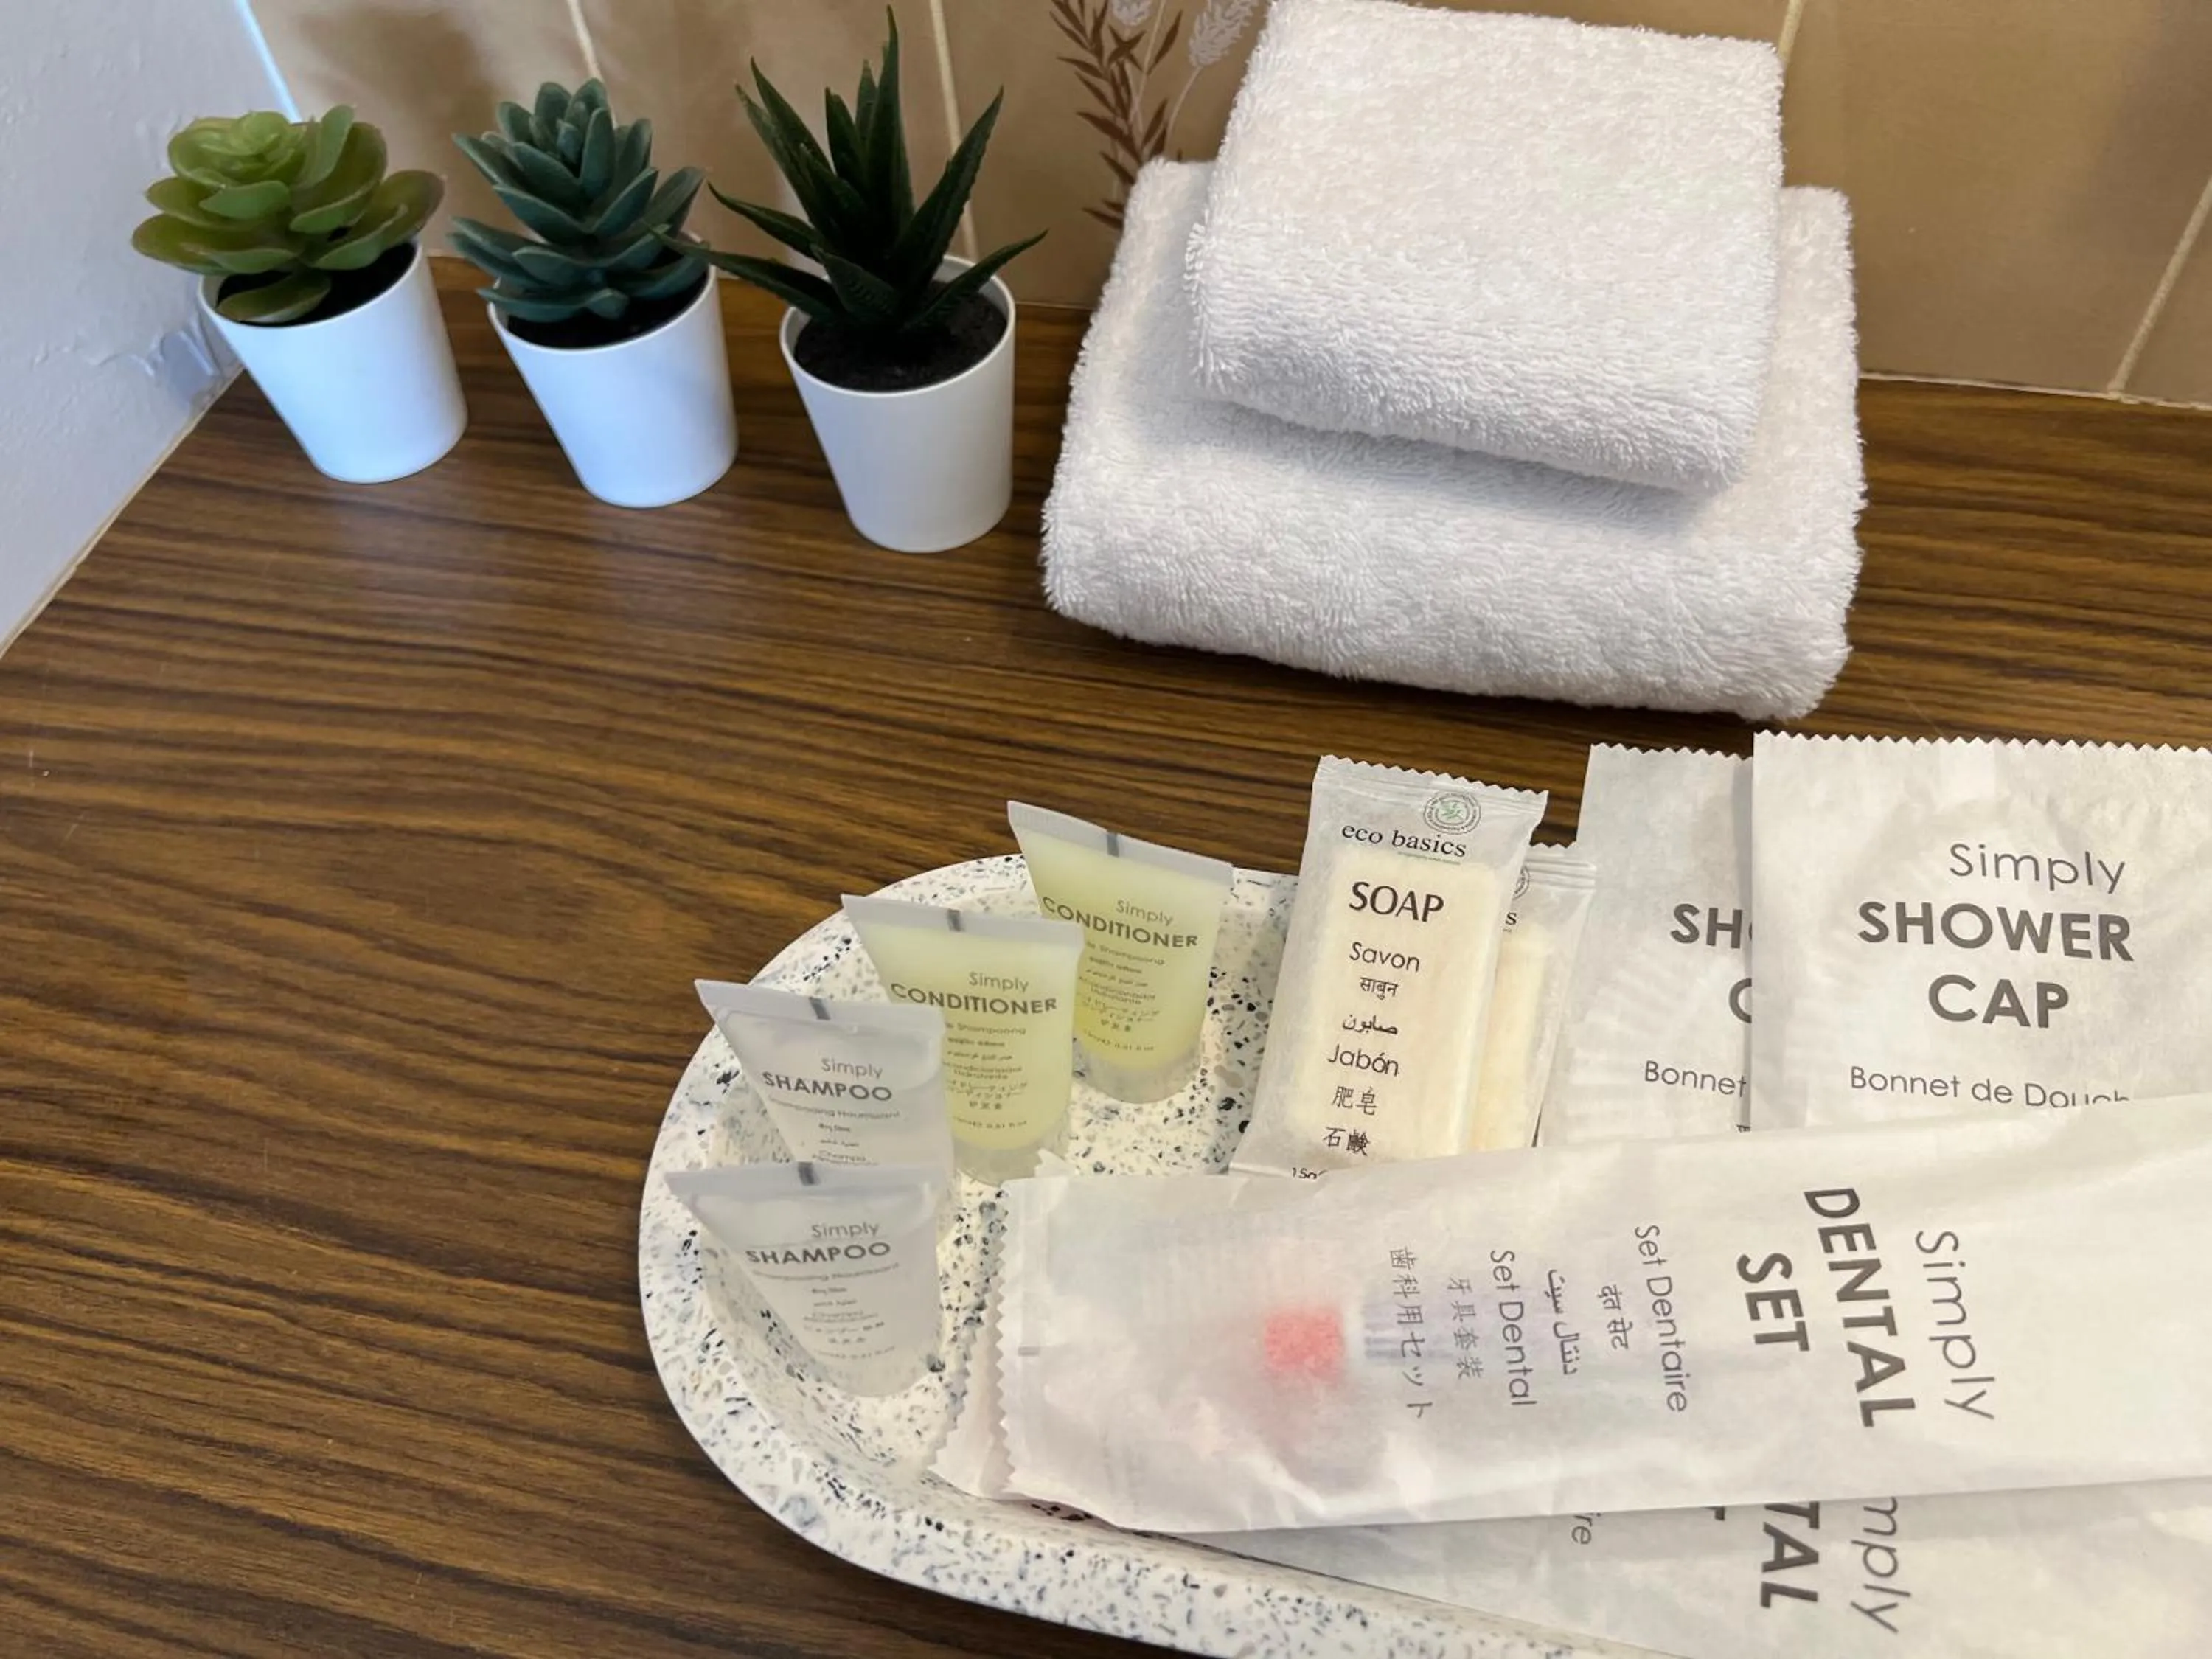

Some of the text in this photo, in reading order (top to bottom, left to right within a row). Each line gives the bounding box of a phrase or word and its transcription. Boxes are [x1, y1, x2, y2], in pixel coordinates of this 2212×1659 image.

[1342, 824, 1467, 857] eco basics
[1950, 844, 2125, 894] Simply
[1116, 900, 1174, 926] Simply
[1349, 881, 1444, 922] SOAP
[1042, 897, 1199, 947] CONDITIONER
[1858, 901, 2134, 961] SHOWER
[1349, 942, 1420, 972] Savon
[968, 971, 1029, 993] Simply
[1360, 976, 1398, 1000] साबुन
[890, 983, 1057, 1015] CONDITIONER
[1928, 974, 2070, 1028] CAP
[821, 1057, 883, 1079] Simply
[1327, 1044, 1399, 1077] Jabón
[762, 1071, 892, 1101] SHAMPOO
[1644, 1060, 1747, 1097] Bonnet
[1851, 1066, 1961, 1097] Bonnet
[1972, 1079, 2013, 1104] de
[1331, 1085, 1377, 1116] 肥皂
[811, 1222, 880, 1238] Simply
[745, 1242, 891, 1264] SHAMPOO
[1635, 1224, 1691, 1413] Set Dentaire
[1736, 1252, 1810, 1352] SET
[1804, 1188, 1916, 1428] DENTAL
[1490, 1249, 1537, 1406] Set Dental
[1607, 1317, 1634, 1350] सेट
[1915, 1230, 1995, 1420] Simply
